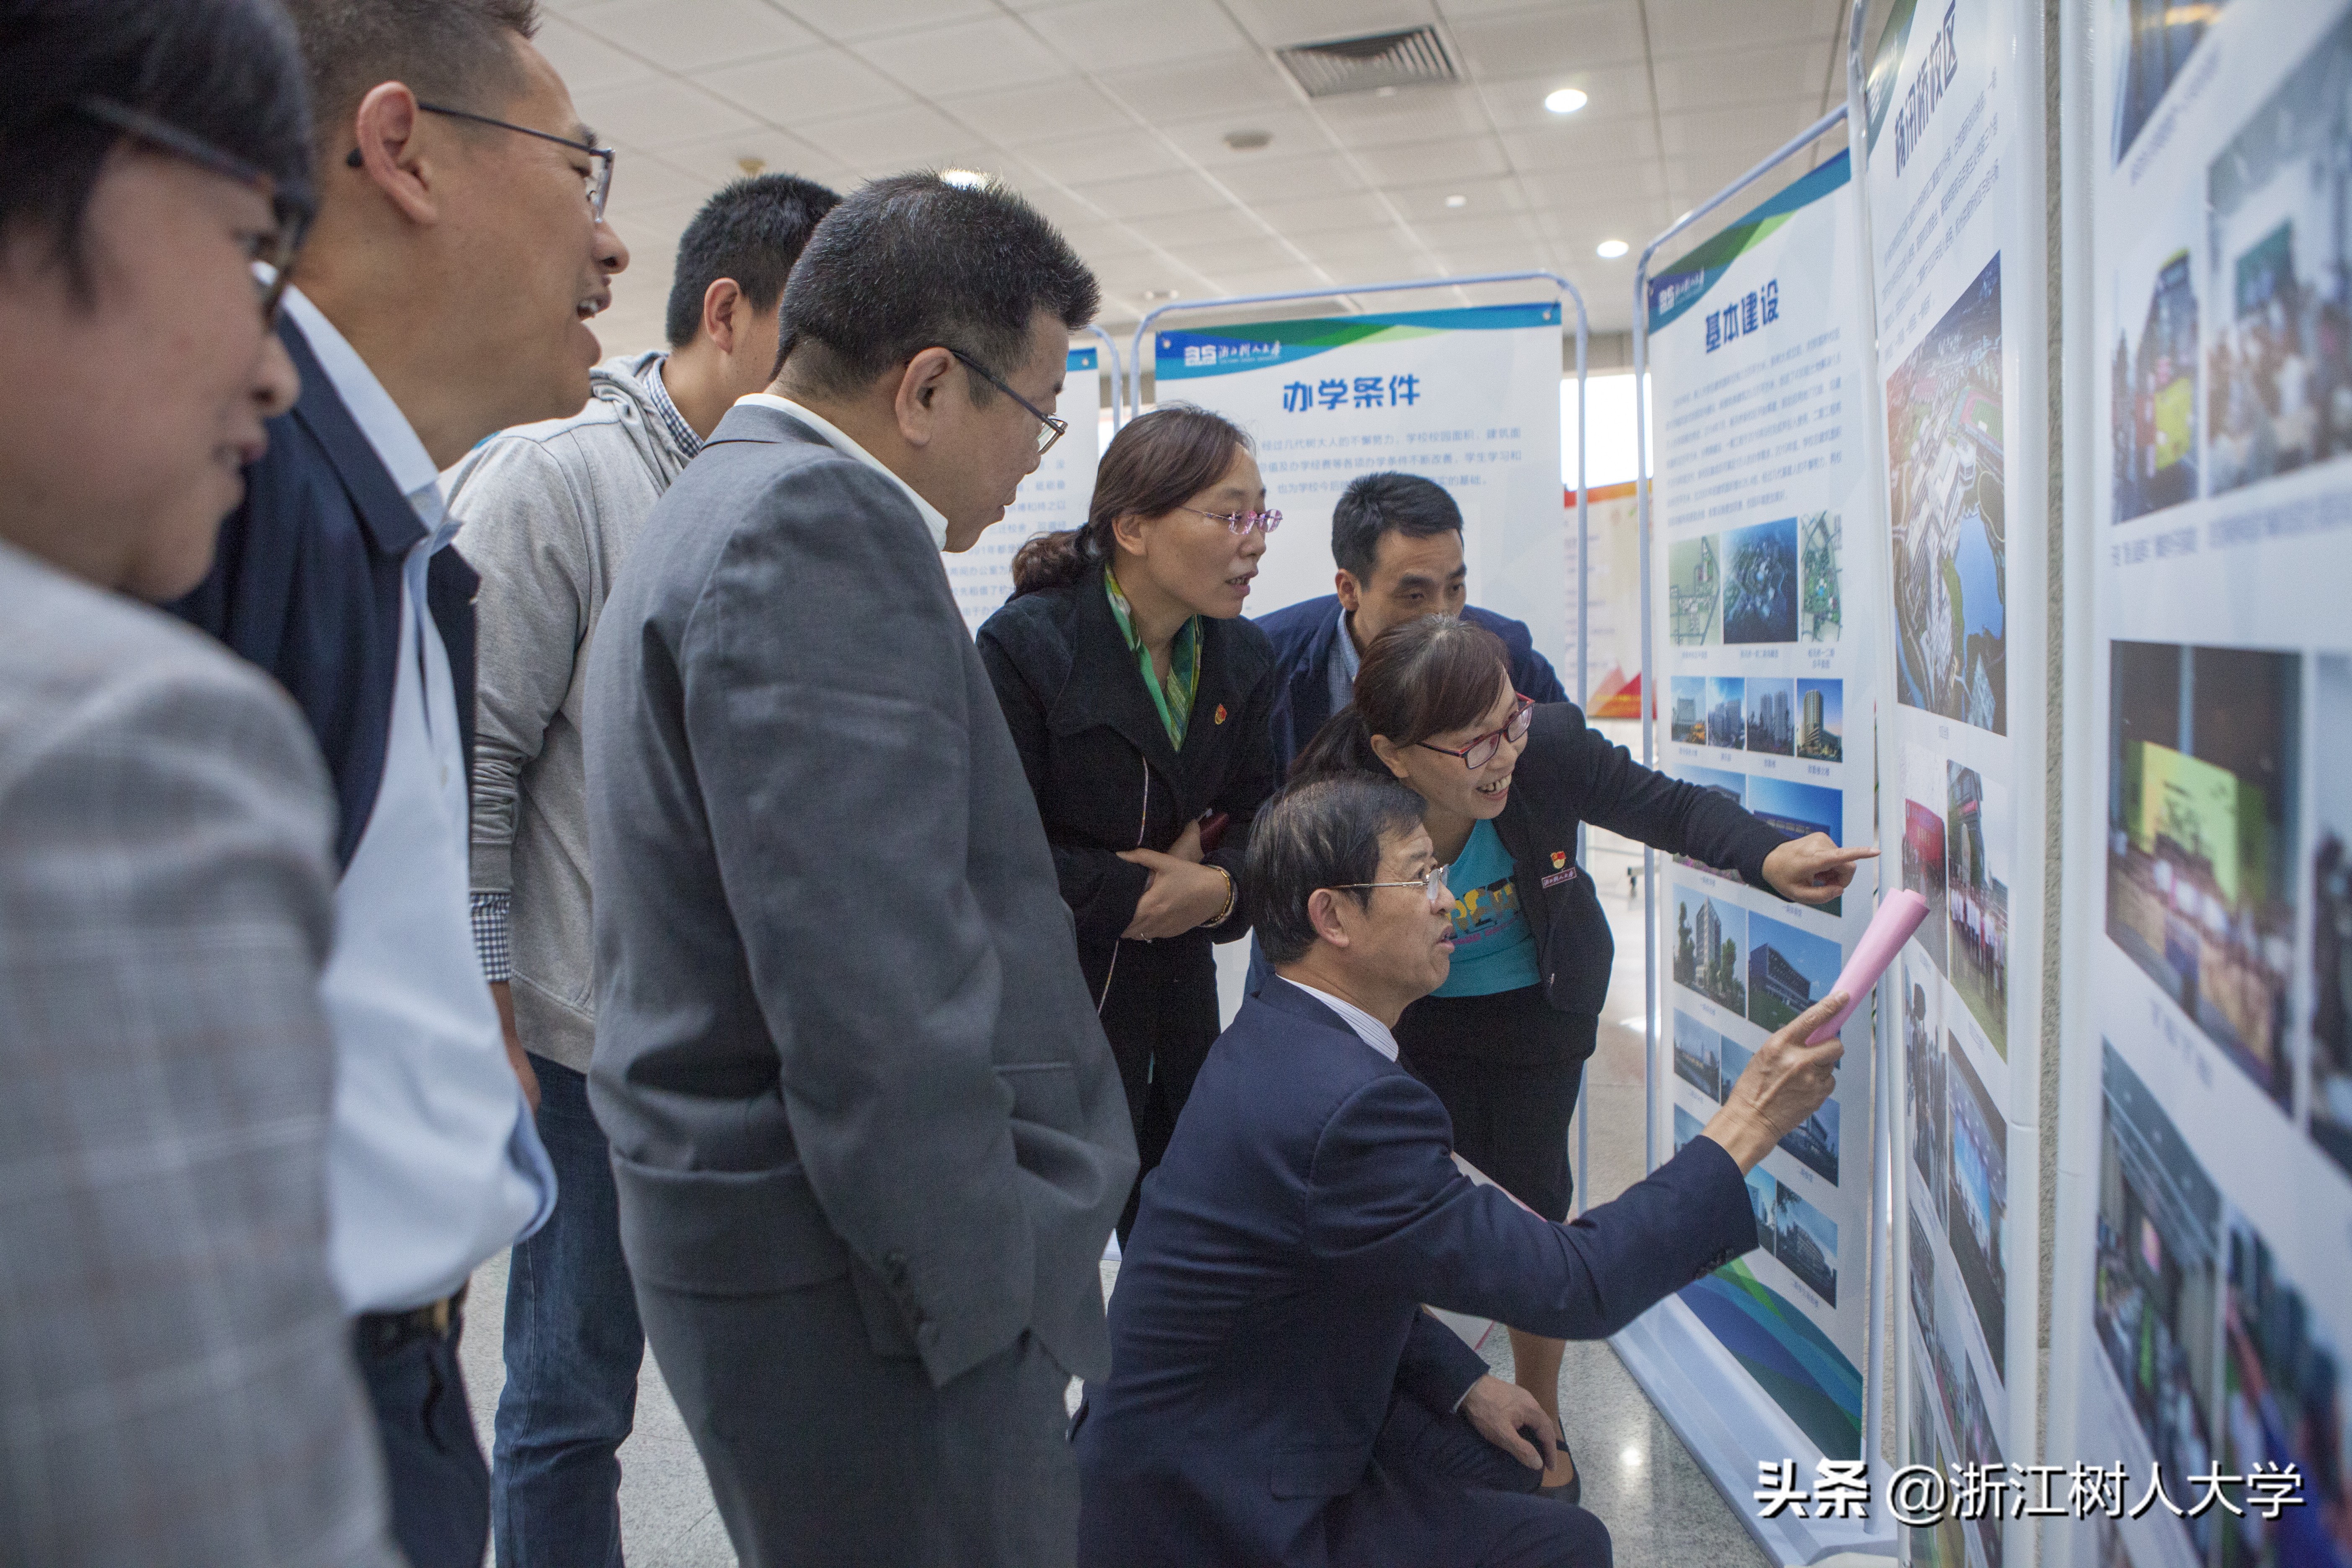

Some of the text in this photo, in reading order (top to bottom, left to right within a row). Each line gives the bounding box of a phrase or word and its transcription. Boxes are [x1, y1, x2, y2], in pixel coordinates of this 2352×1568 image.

[1705, 278, 1779, 354] 基本建设
[1283, 374, 1420, 413] 办学条件
